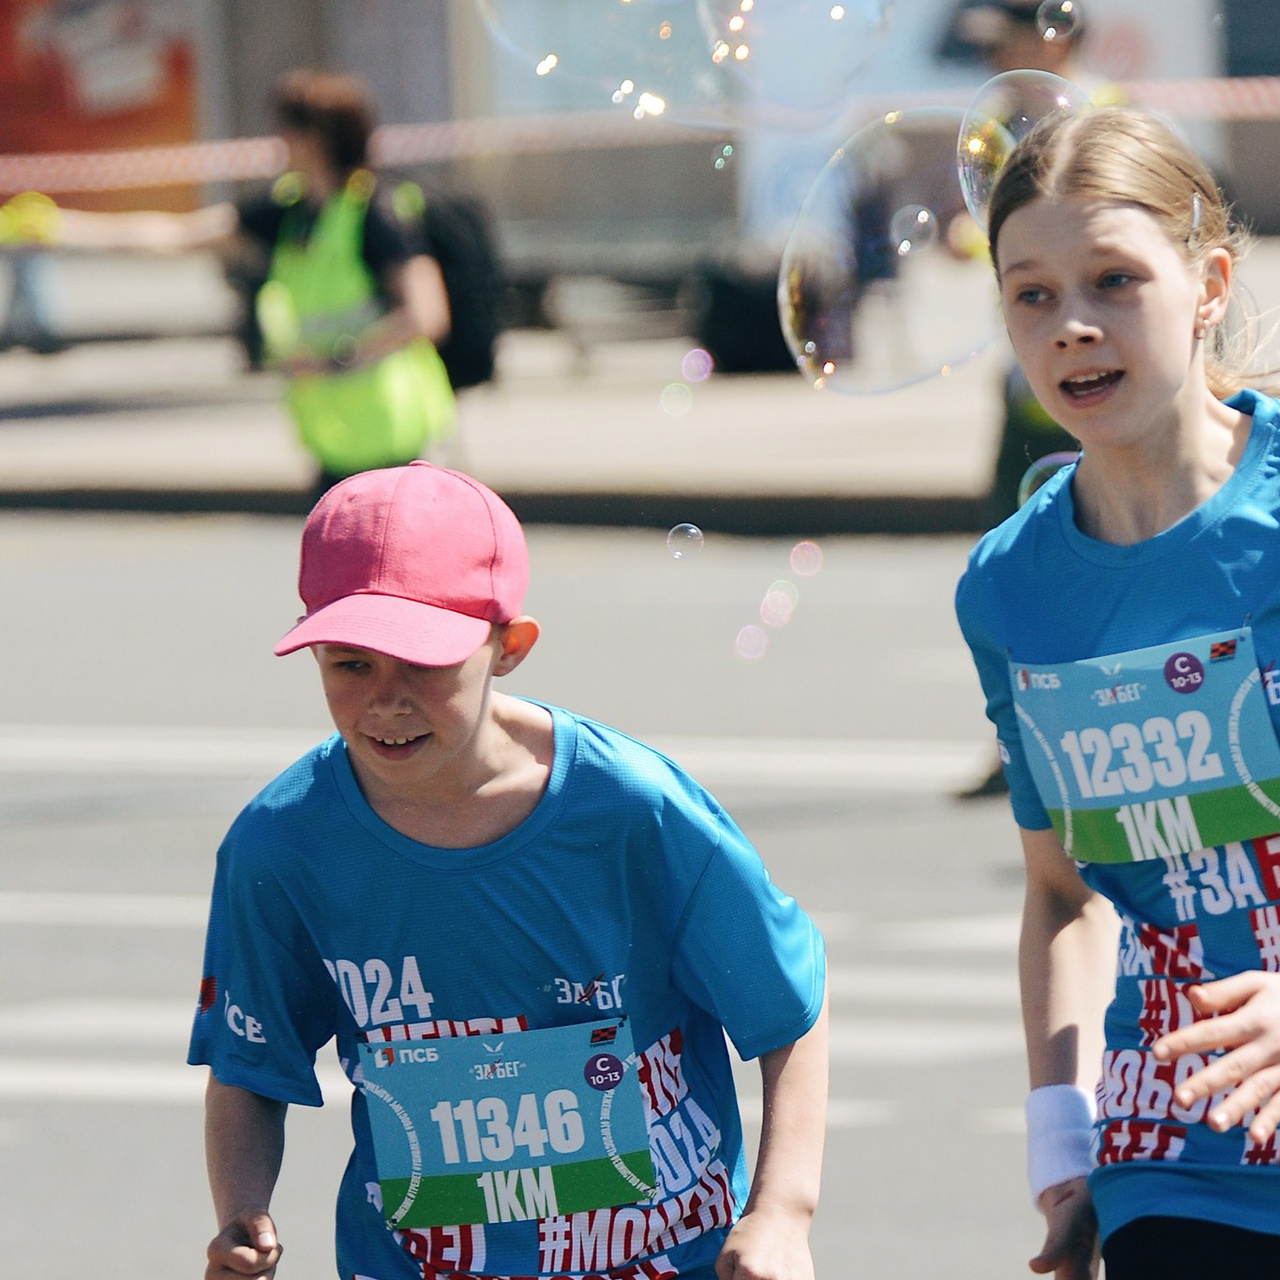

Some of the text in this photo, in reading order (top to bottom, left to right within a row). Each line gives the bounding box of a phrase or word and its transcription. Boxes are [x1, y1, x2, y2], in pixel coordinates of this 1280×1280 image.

[1032, 672, 1061, 690] ПСБ
[1171, 675, 1203, 689] 10-13
[1060, 710, 1225, 799] 12332
[224, 990, 267, 1044] СБ
[322, 956, 434, 1028] 024
[399, 1047, 440, 1064] ПСБ
[590, 1071, 621, 1086] 10-13
[430, 1089, 586, 1166] 11346
[649, 1097, 722, 1203] 024
